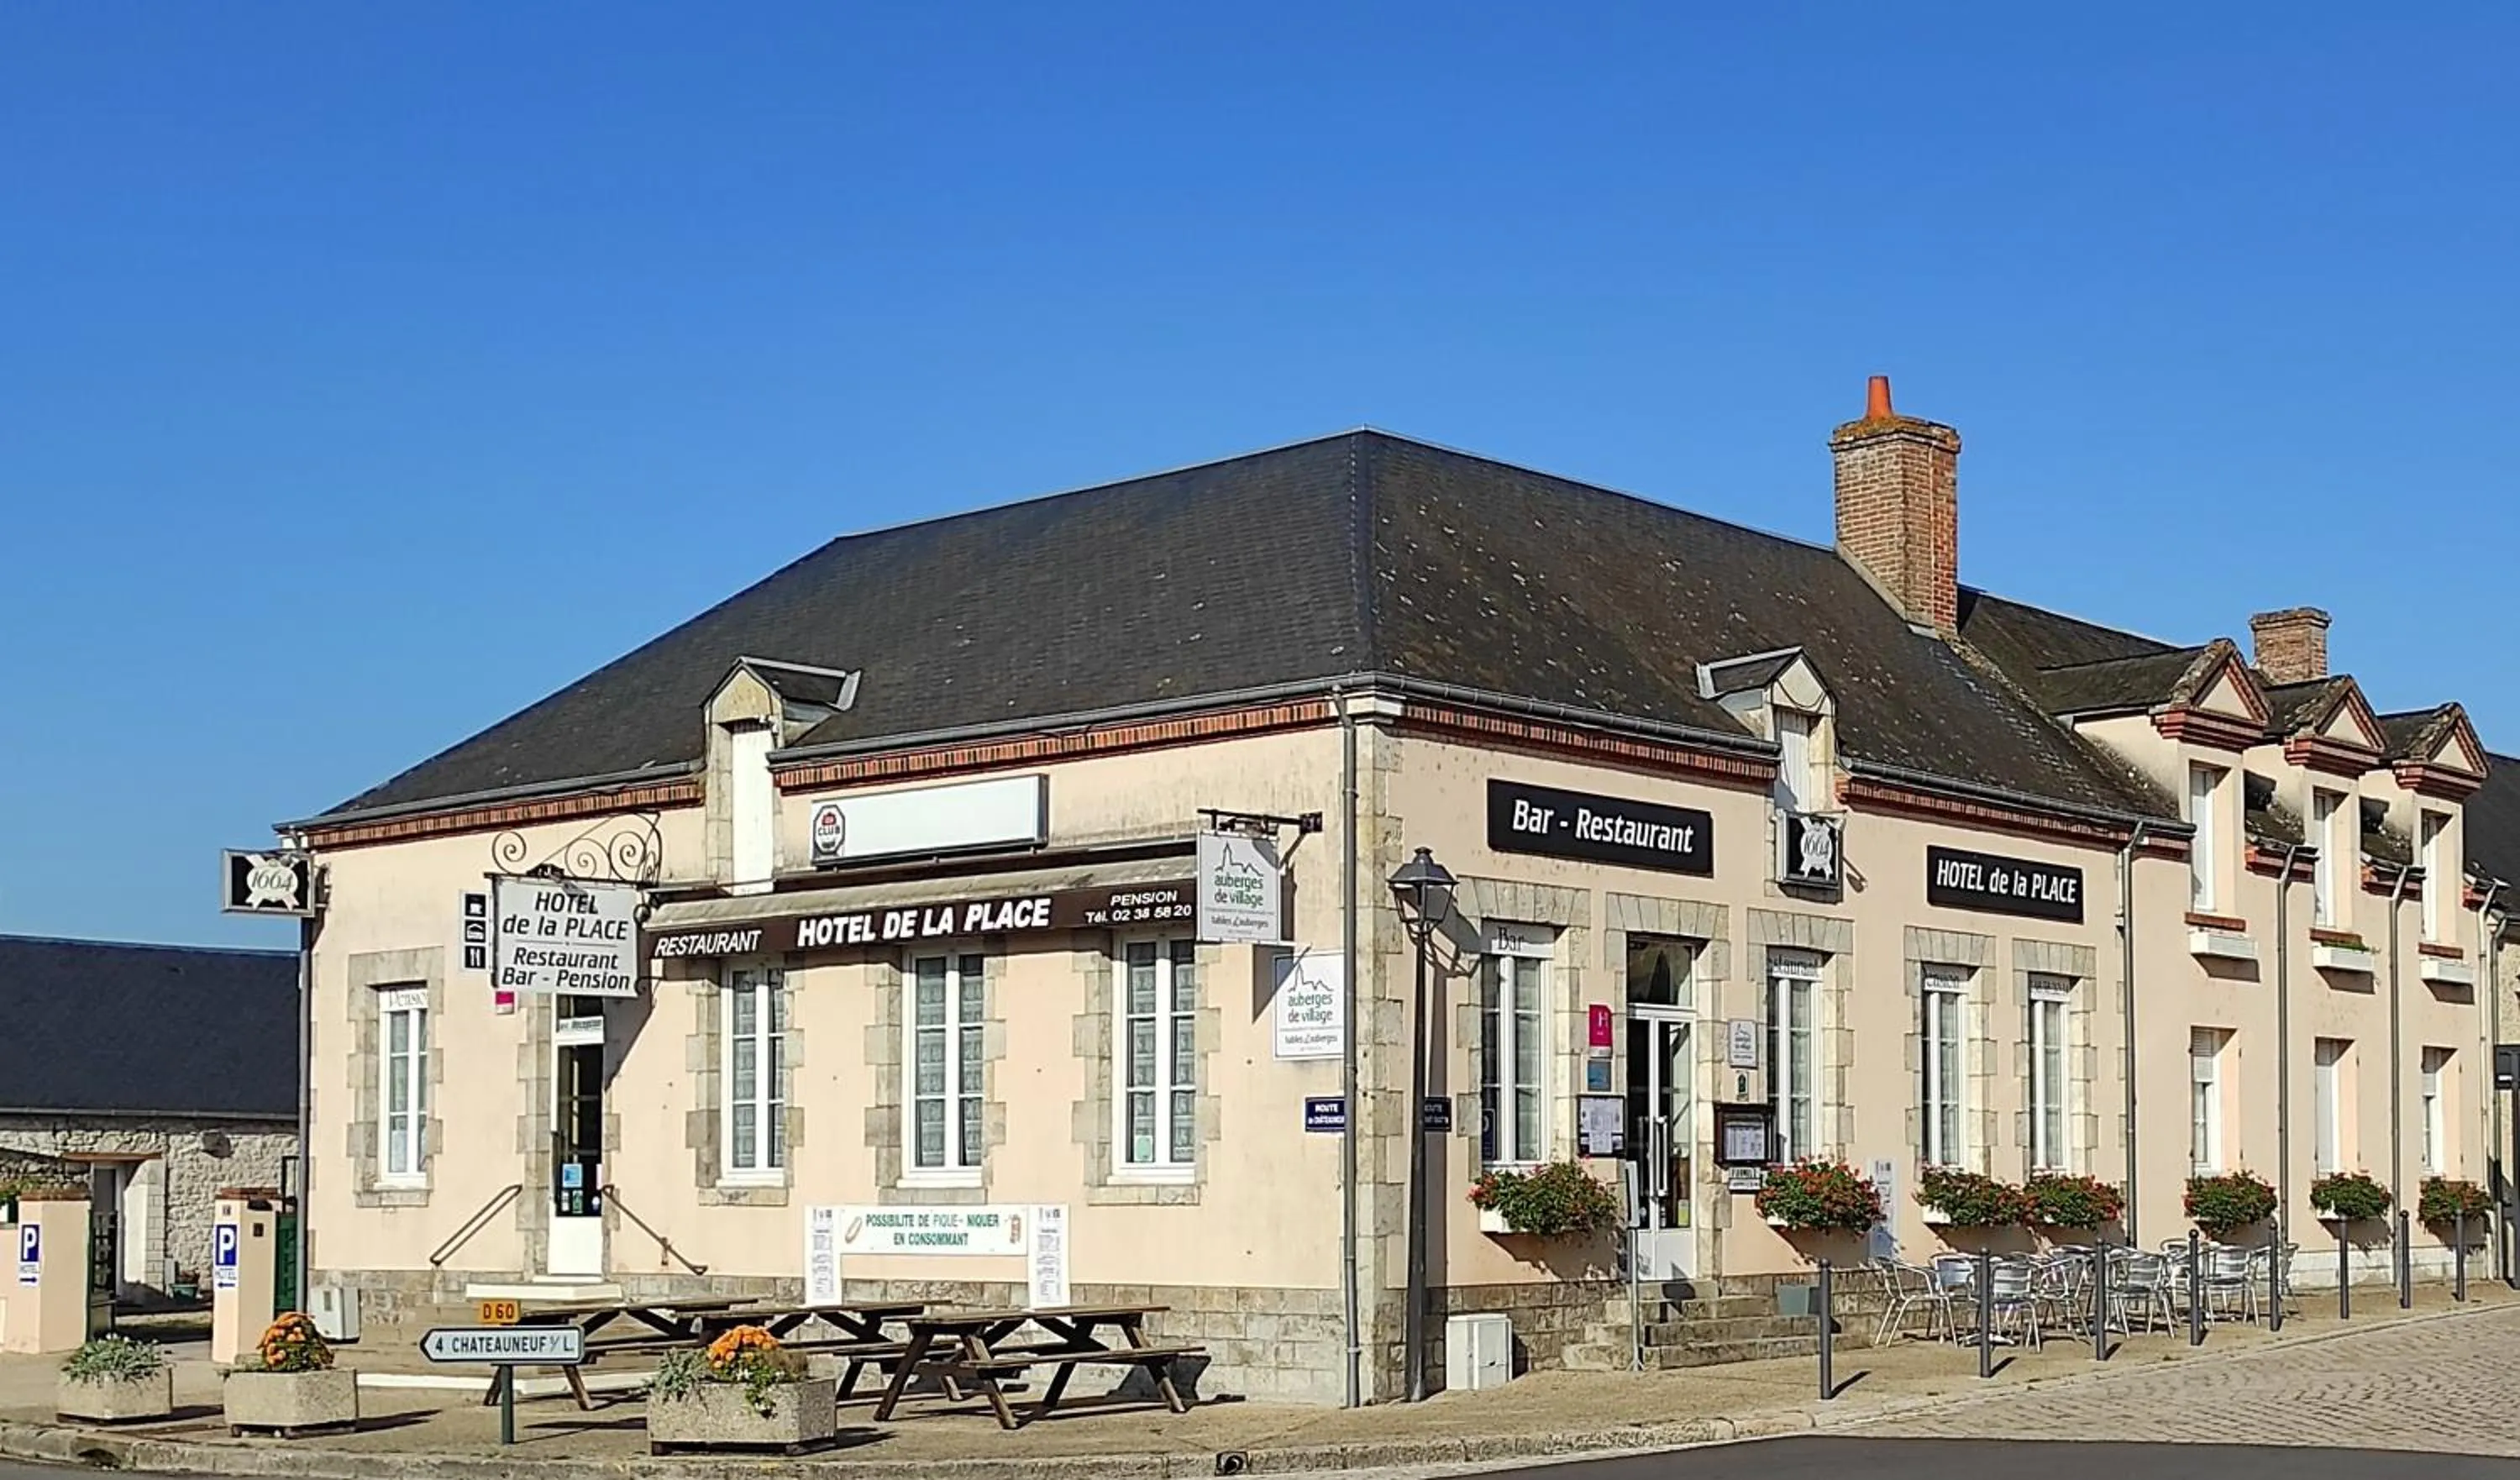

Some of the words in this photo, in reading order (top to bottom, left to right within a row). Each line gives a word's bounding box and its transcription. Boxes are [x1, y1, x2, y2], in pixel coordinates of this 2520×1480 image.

[1512, 799, 1554, 834] Bar
[1575, 808, 1694, 853] Restaurant
[1214, 873, 1263, 891] auberges
[1936, 858, 1985, 891] HOTEL
[1989, 867, 2008, 894] de
[2013, 870, 2027, 897] la
[2031, 874, 2076, 904] PLACE
[535, 892, 598, 914] HOTEL
[1110, 890, 1178, 906] PENSION
[1214, 889, 1228, 903] de
[1229, 890, 1264, 908] village
[1112, 909, 1131, 921] 02
[1133, 907, 1150, 920] 38
[1173, 905, 1192, 916] 20
[502, 914, 530, 935] de
[538, 916, 557, 937] la
[564, 917, 628, 940] PLACE
[655, 930, 762, 957] RESTAURANT
[798, 914, 875, 947] HOTEL
[883, 910, 918, 940] DE
[921, 906, 953, 937] LA
[964, 898, 1051, 932] PLACE
[1498, 926, 1525, 952] Bar
[513, 947, 619, 969] Restaurant
[501, 967, 537, 985] Bar
[556, 969, 630, 989] Pension
[1288, 992, 1333, 1008] auberges
[1288, 1010, 1299, 1023] de
[1301, 1010, 1333, 1024] village
[866, 1214, 914, 1227] POSSIBILITE
[918, 1214, 929, 1226] DE
[24, 1227, 36, 1259] P
[219, 1227, 234, 1264] P
[894, 1232, 905, 1245] EN
[909, 1232, 969, 1245] CONSOMMANT
[483, 1304, 491, 1319] D
[496, 1304, 514, 1319] 60
[435, 1336, 443, 1351] 4
[452, 1336, 546, 1352] CHATEAUNEUF
